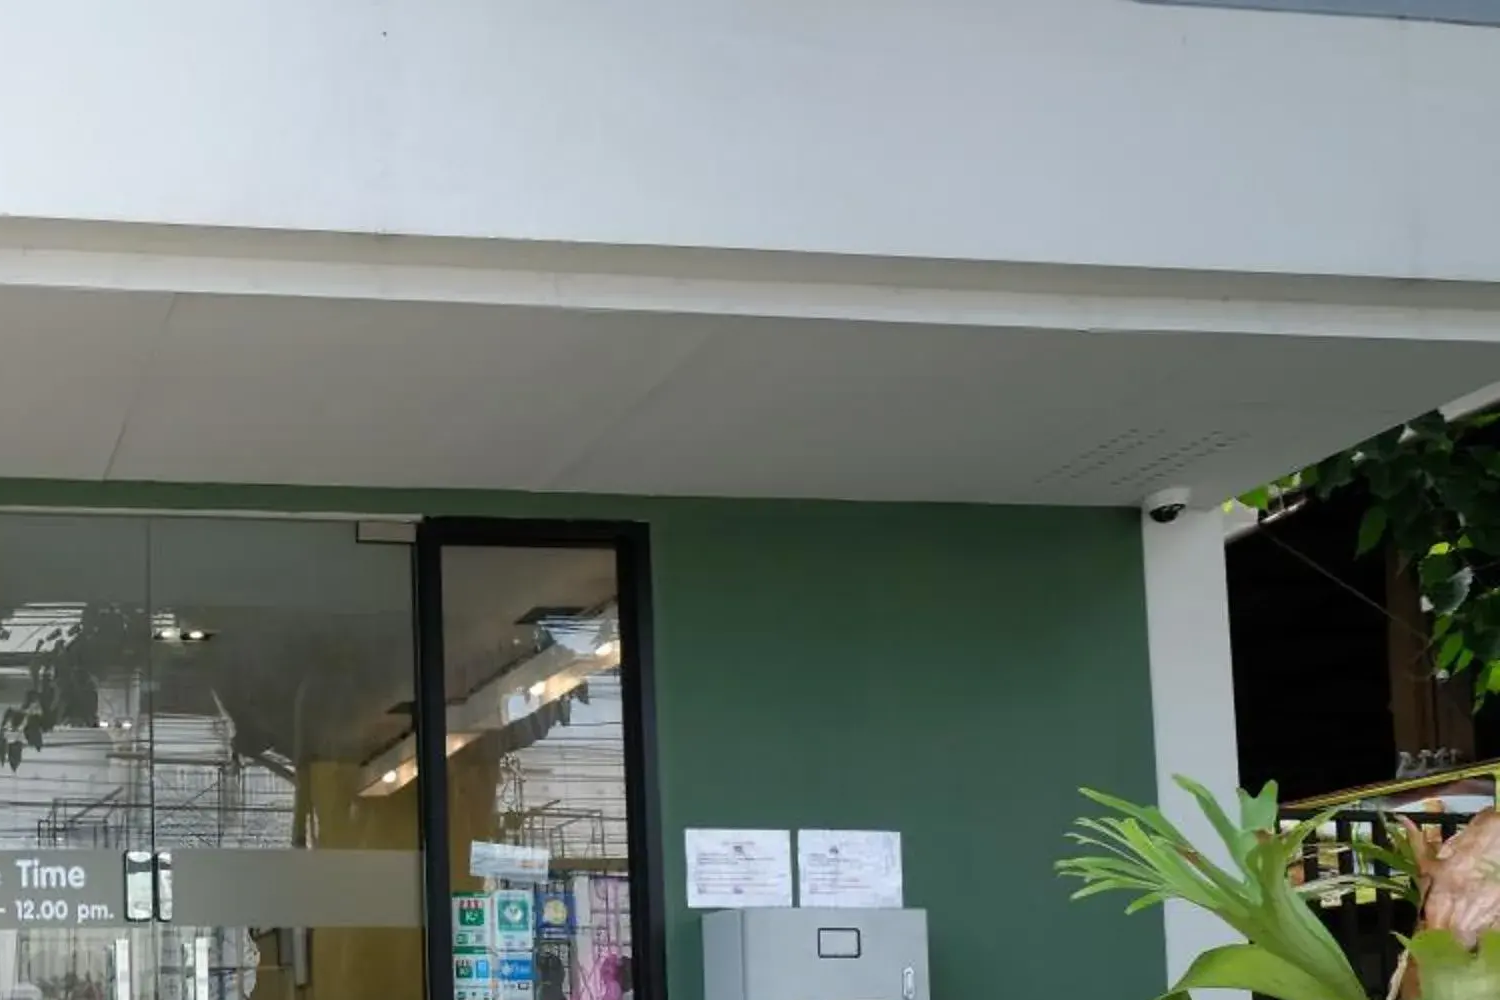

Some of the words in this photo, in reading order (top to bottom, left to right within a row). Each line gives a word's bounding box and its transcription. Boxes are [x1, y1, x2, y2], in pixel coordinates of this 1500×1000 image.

[15, 857, 86, 889] Time
[15, 900, 69, 920] 12.00
[76, 904, 115, 924] pm.
